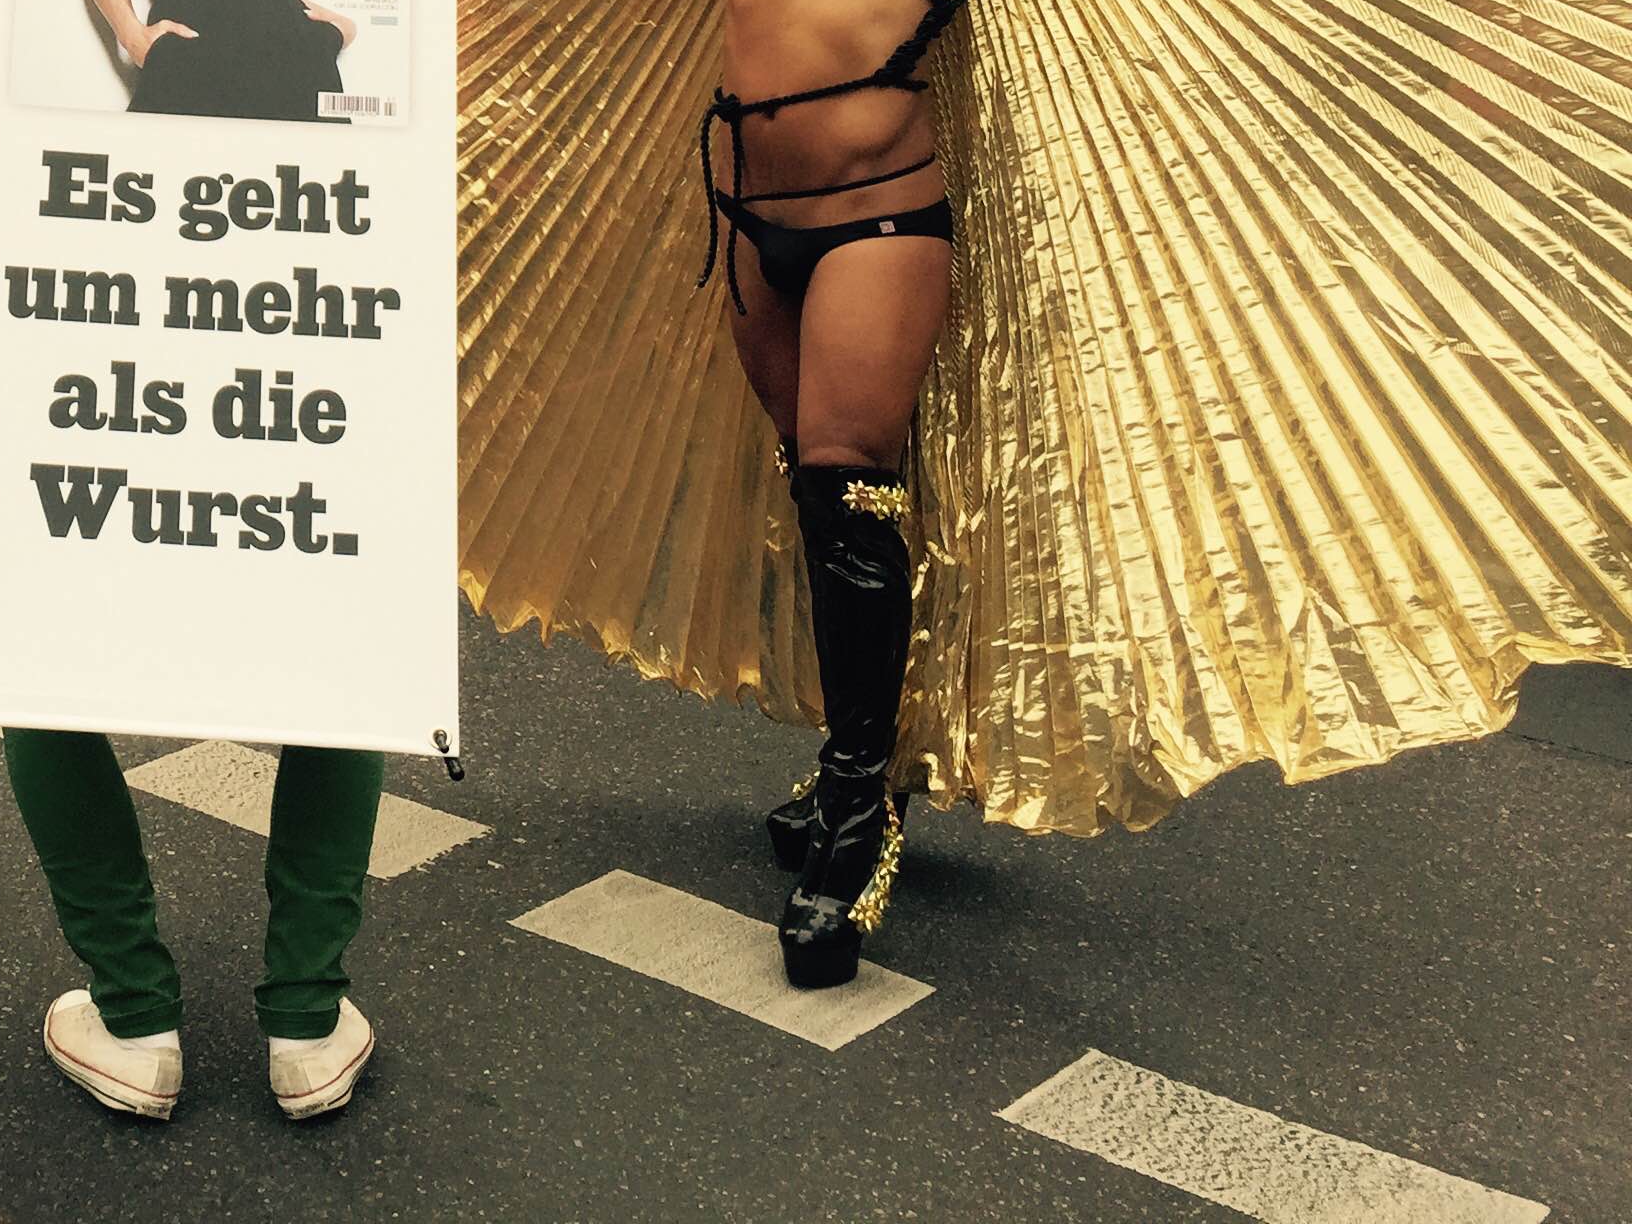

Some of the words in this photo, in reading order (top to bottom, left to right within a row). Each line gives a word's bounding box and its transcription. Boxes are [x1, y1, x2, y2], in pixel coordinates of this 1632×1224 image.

[38, 150, 156, 224] Es
[178, 164, 371, 242] geht
[4, 264, 140, 326] um
[163, 267, 401, 340] mehr
[48, 361, 186, 436] als
[212, 368, 347, 444] die
[29, 462, 359, 557] Wurst.
